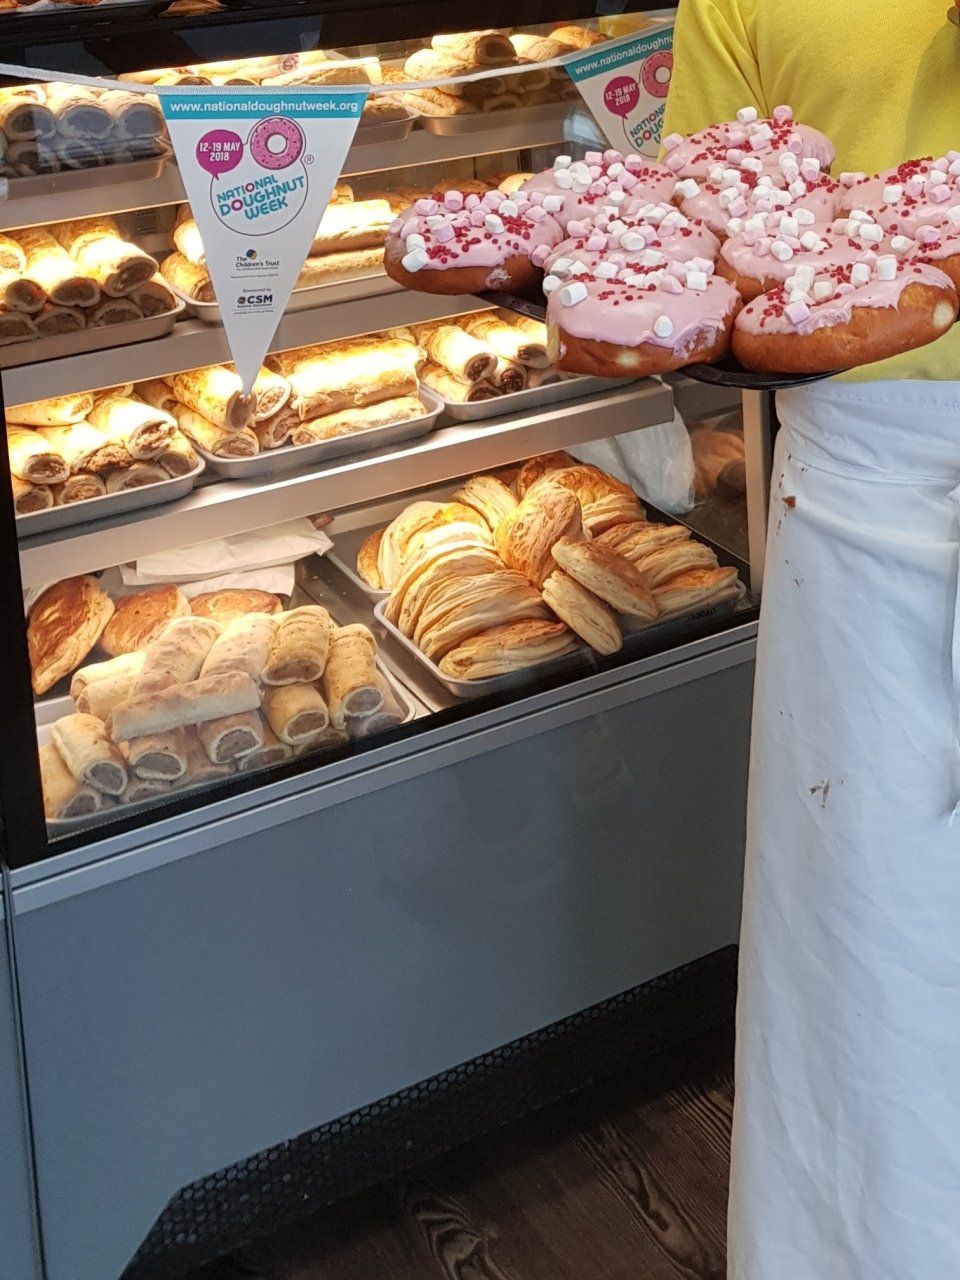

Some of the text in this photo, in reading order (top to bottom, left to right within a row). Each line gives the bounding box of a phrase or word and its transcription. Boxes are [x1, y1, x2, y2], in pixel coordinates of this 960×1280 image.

[622, 82, 637, 93] MAY
[169, 100, 359, 114] www.nationaldoughnutweek.org
[199, 141, 241, 152] 12-19 MAY
[209, 152, 230, 162] 2018
[216, 174, 279, 204] NATIONAL
[218, 175, 305, 217] DOUGHNUT
[244, 196, 289, 220] WEEK
[247, 294, 273, 304] CSM
